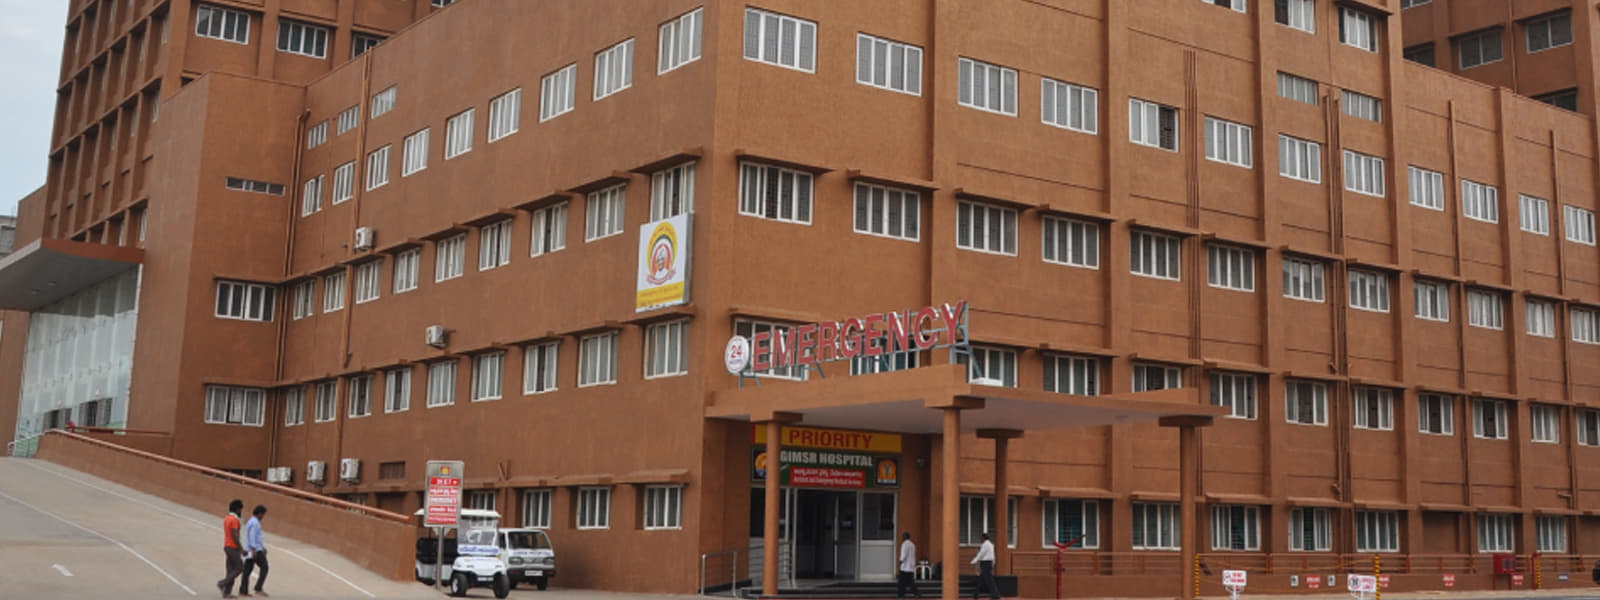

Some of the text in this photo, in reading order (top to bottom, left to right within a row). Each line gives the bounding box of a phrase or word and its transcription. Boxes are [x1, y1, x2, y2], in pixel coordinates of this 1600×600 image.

[752, 301, 964, 371] EMERGENCY
[731, 345, 742, 358] 24
[789, 430, 873, 449] PRIORITY
[819, 452, 873, 466] HOSPITAL
